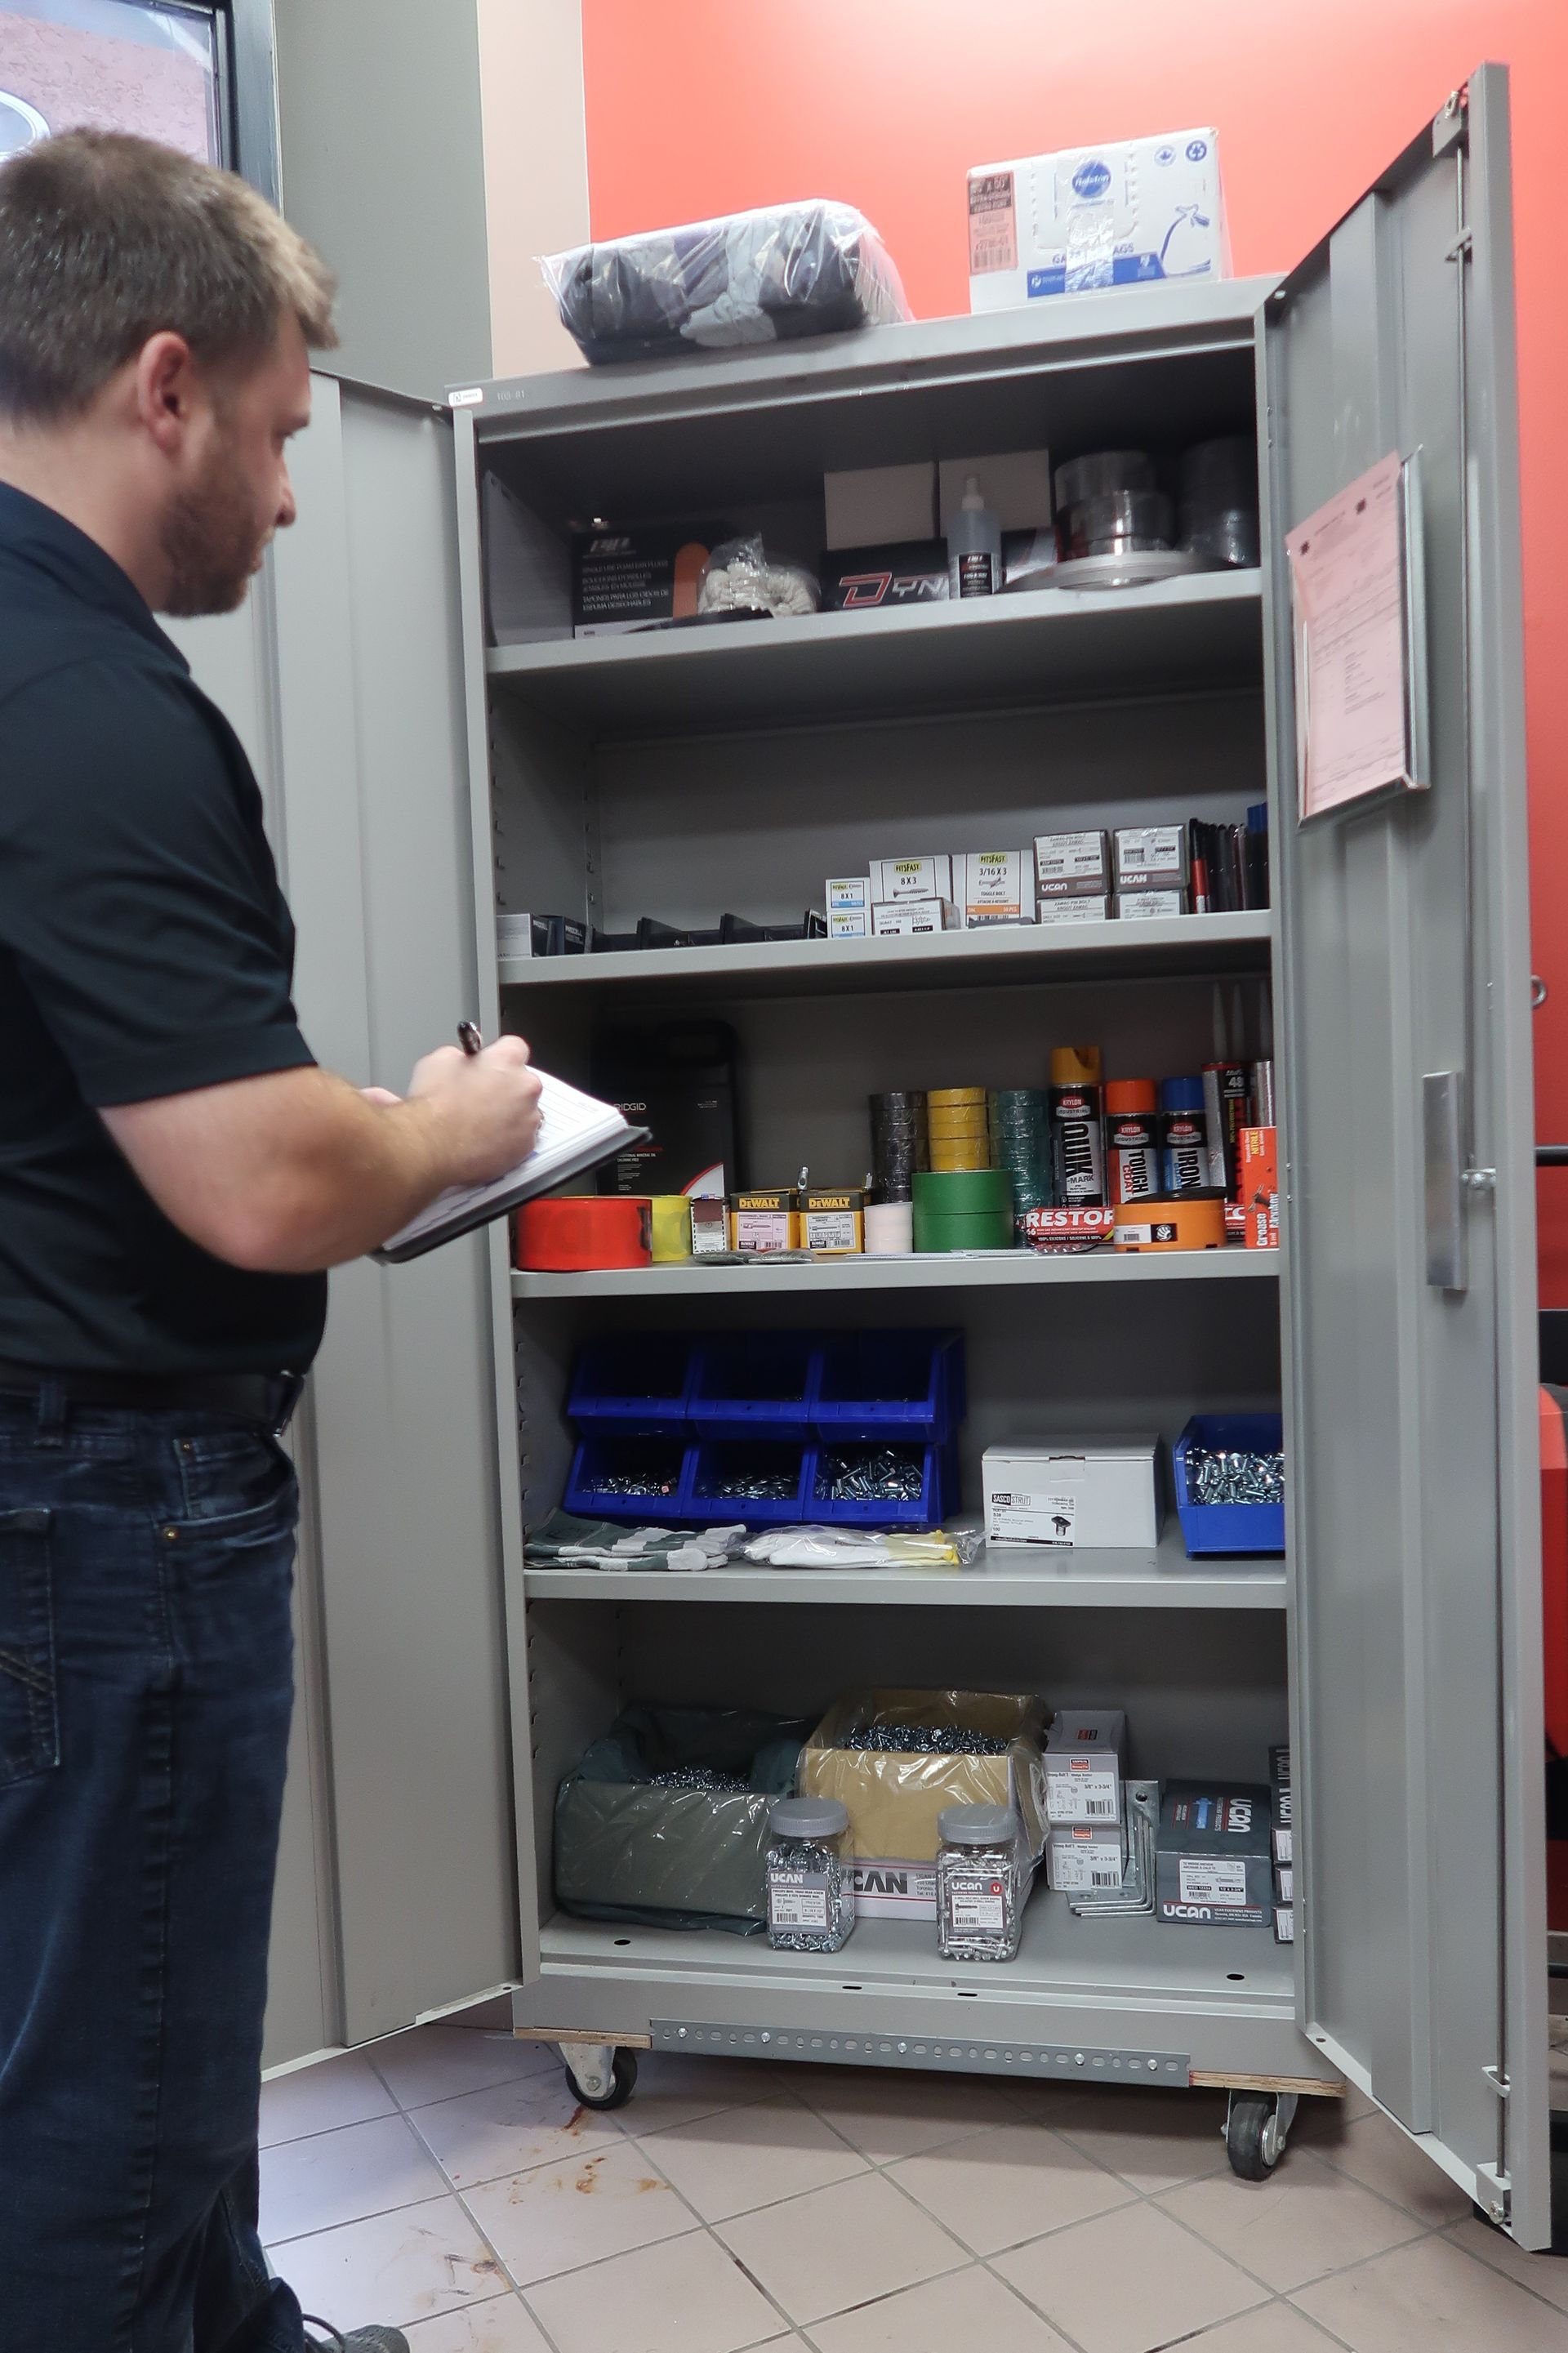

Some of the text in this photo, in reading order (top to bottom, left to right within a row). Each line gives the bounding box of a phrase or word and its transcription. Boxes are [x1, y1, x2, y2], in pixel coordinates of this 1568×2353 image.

[839, 572, 950, 608] DYN
[895, 863, 920, 871] FITSFAST
[980, 854, 1005, 863] FITSFAST
[979, 867, 996, 876] 3/16
[996, 867, 1001, 876] X
[901, 877, 906, 885] 8
[613, 1103, 647, 1112] RIDGID
[1062, 1122, 1094, 1178] QUIK
[1250, 1130, 1259, 1155] NITRILE
[1129, 1149, 1149, 1194] TOUGH
[1178, 1150, 1202, 1188] IRON
[1256, 1213, 1267, 1246] Grease
[992, 1494, 1028, 1504] SASCO STRUT
[771, 1873, 804, 1883] UCAN
[854, 1869, 908, 1894] CAN
